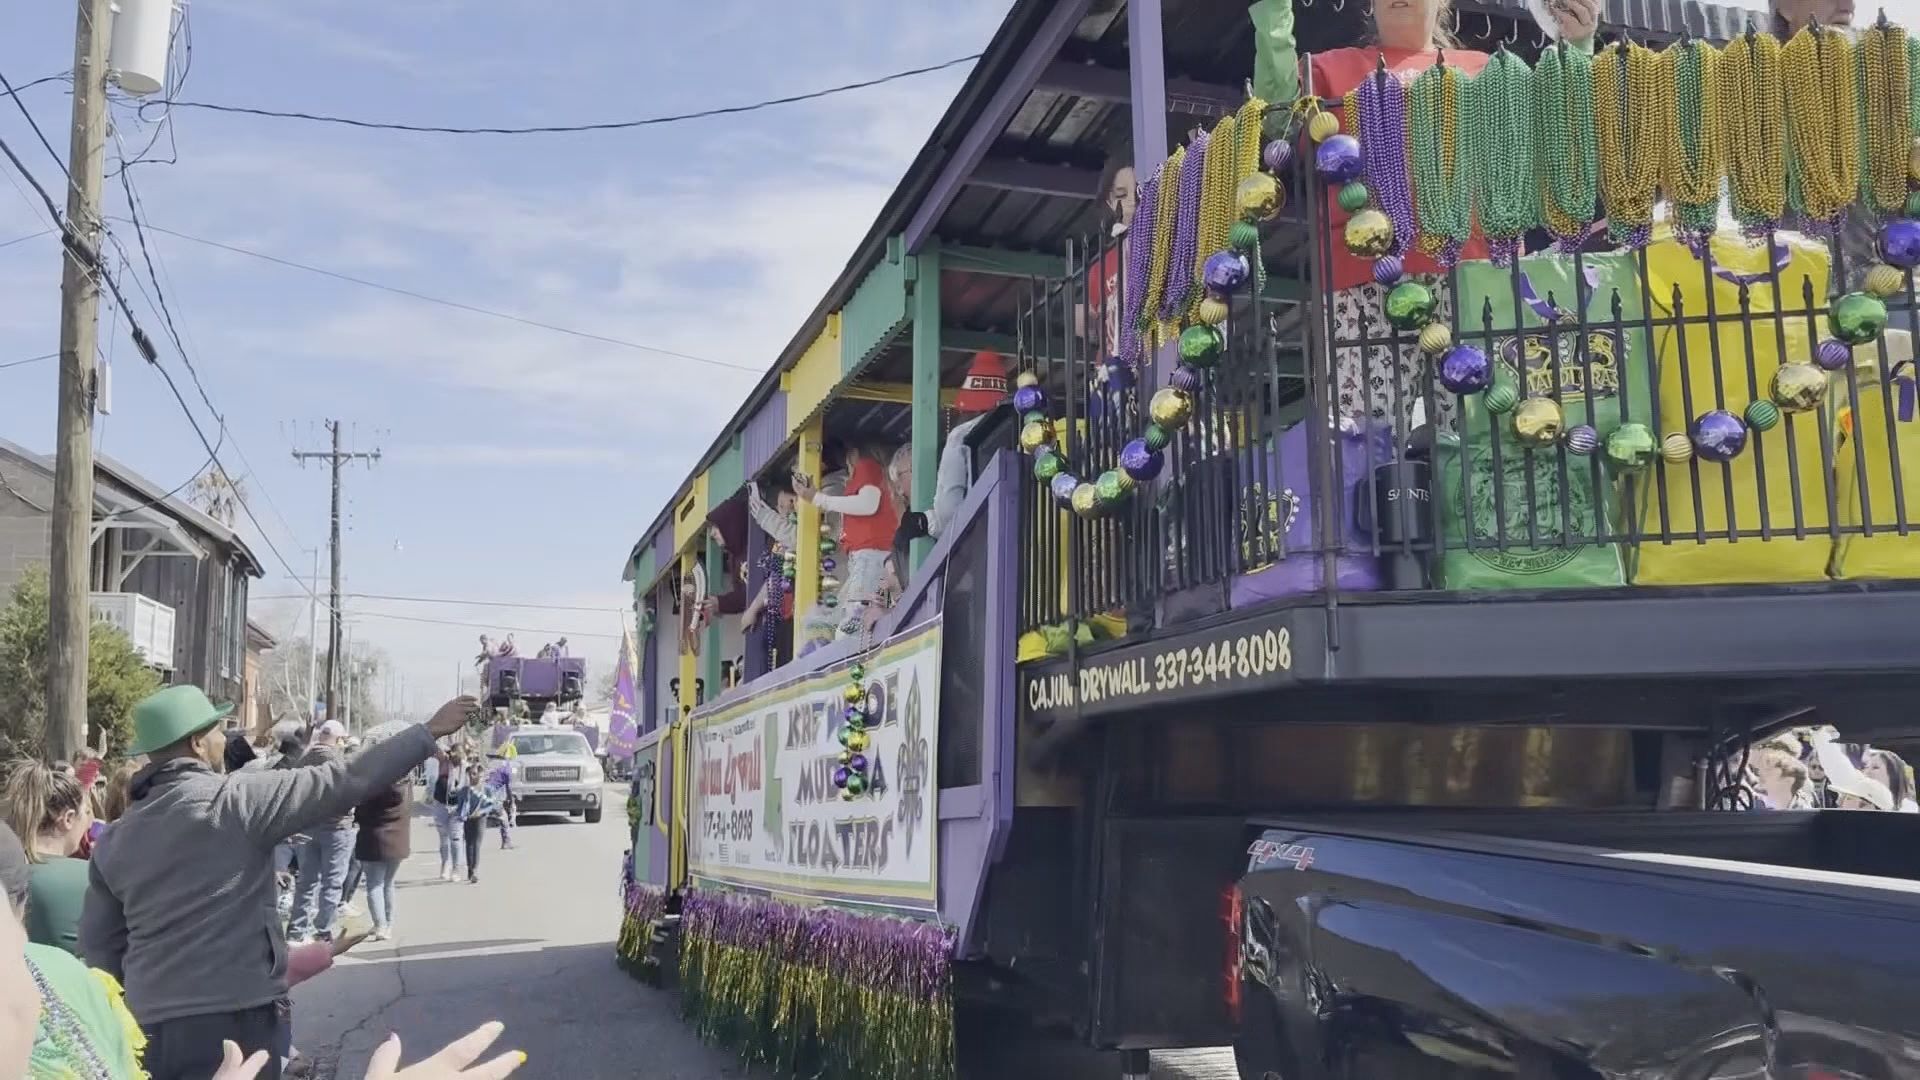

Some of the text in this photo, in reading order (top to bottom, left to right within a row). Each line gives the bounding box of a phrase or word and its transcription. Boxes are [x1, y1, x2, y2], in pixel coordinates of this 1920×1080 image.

[1387, 488, 1430, 502] SANTS
[1029, 626, 1292, 711] CAJUN DRYWALL 337-344-8098
[794, 744, 889, 805] MUDA
[786, 812, 895, 875] FLOATERS
